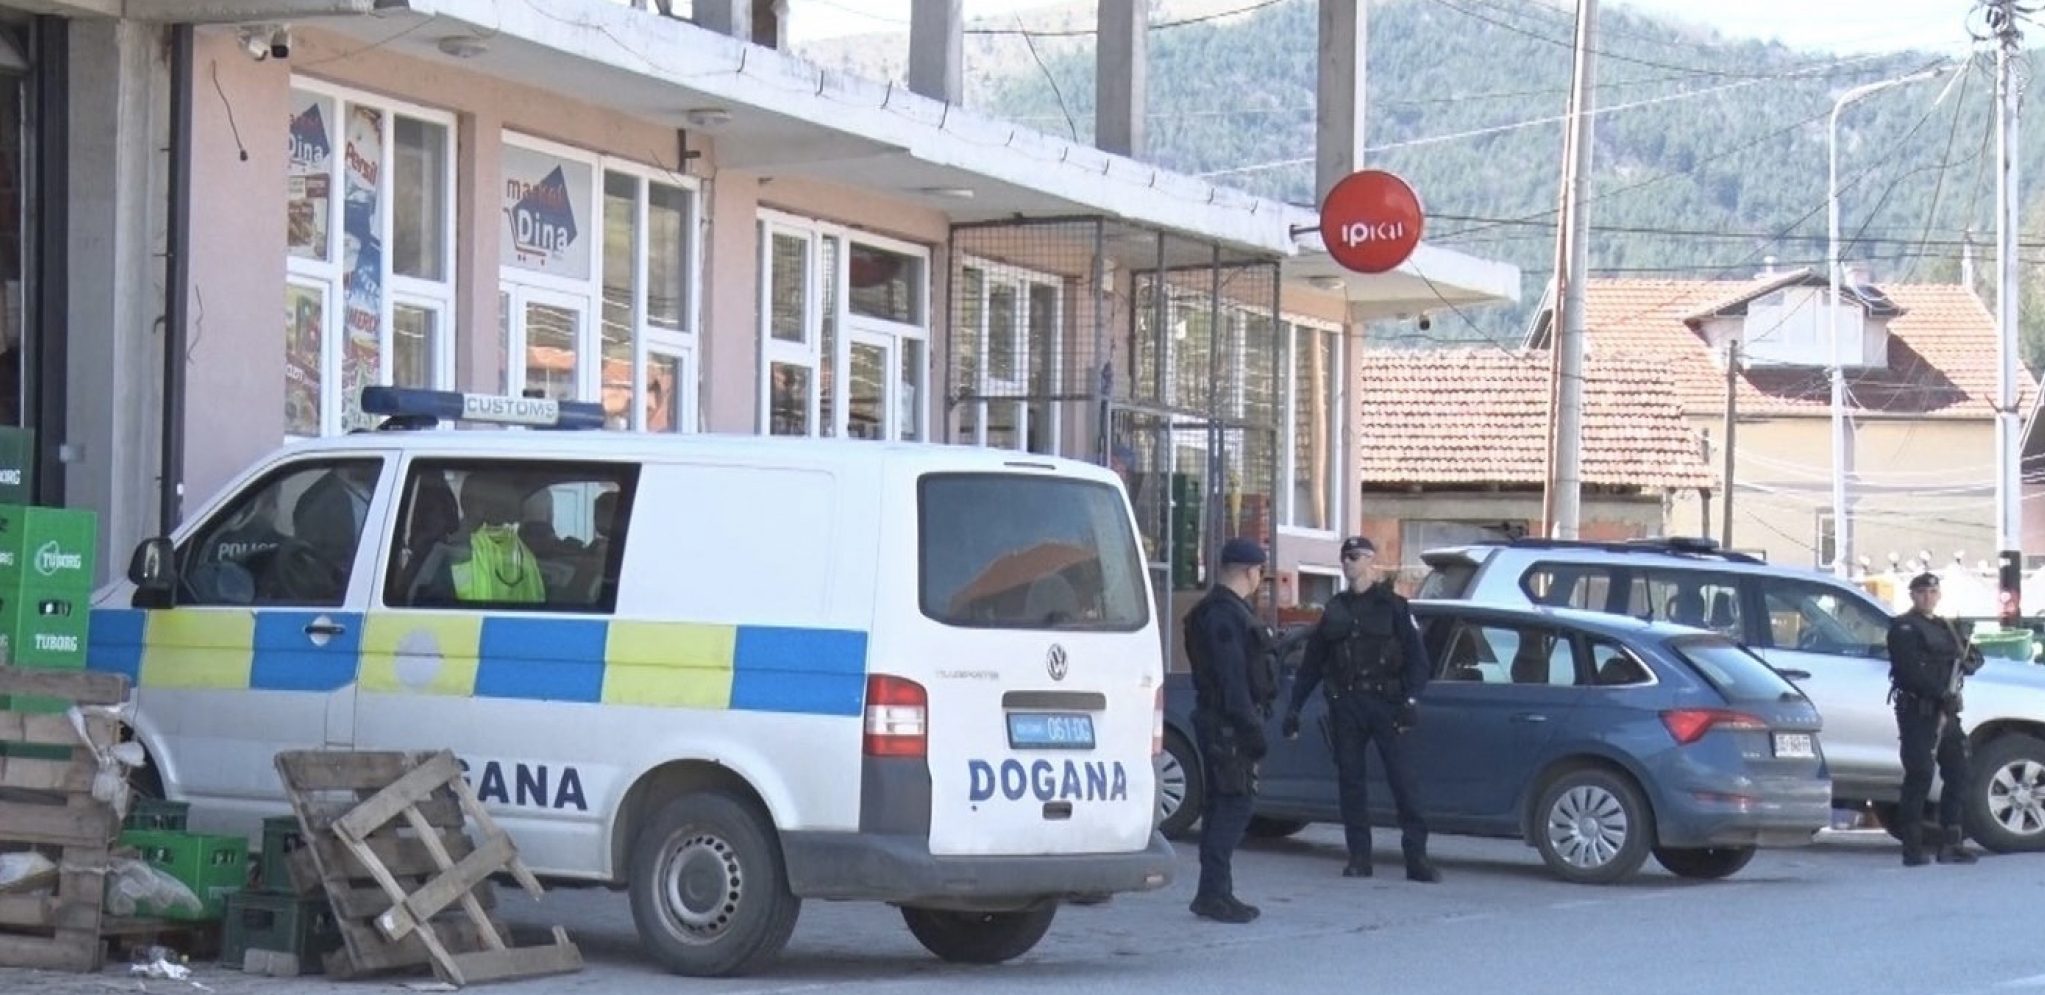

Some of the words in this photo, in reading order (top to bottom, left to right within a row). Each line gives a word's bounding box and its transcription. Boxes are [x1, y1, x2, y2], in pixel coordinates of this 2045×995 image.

[345, 140, 378, 186] Persil
[517, 208, 569, 253] Dina
[466, 397, 556, 419] CUSTOMS
[42, 552, 82, 569] TUBORG
[35, 633, 78, 652] TUBORG
[968, 758, 1128, 802] DOGANA
